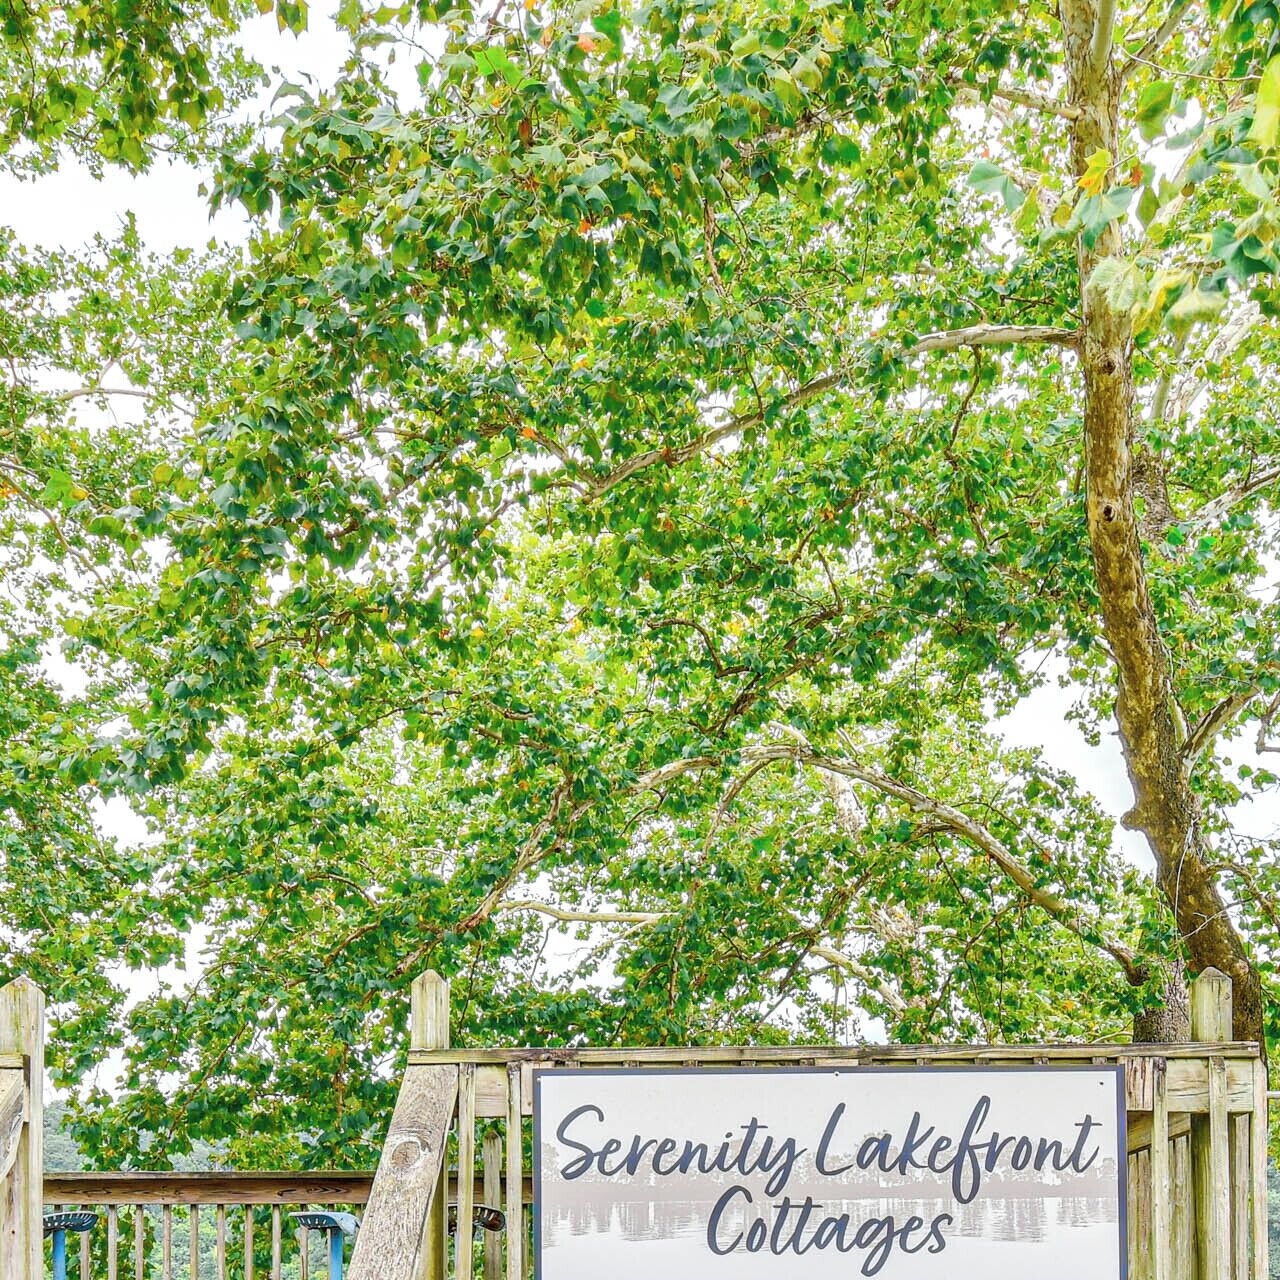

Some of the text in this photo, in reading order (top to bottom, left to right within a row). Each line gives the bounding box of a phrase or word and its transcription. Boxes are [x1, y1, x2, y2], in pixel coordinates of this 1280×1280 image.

[556, 1095, 1103, 1205] Serenity Lakefront
[707, 1185, 954, 1277] Cottages
